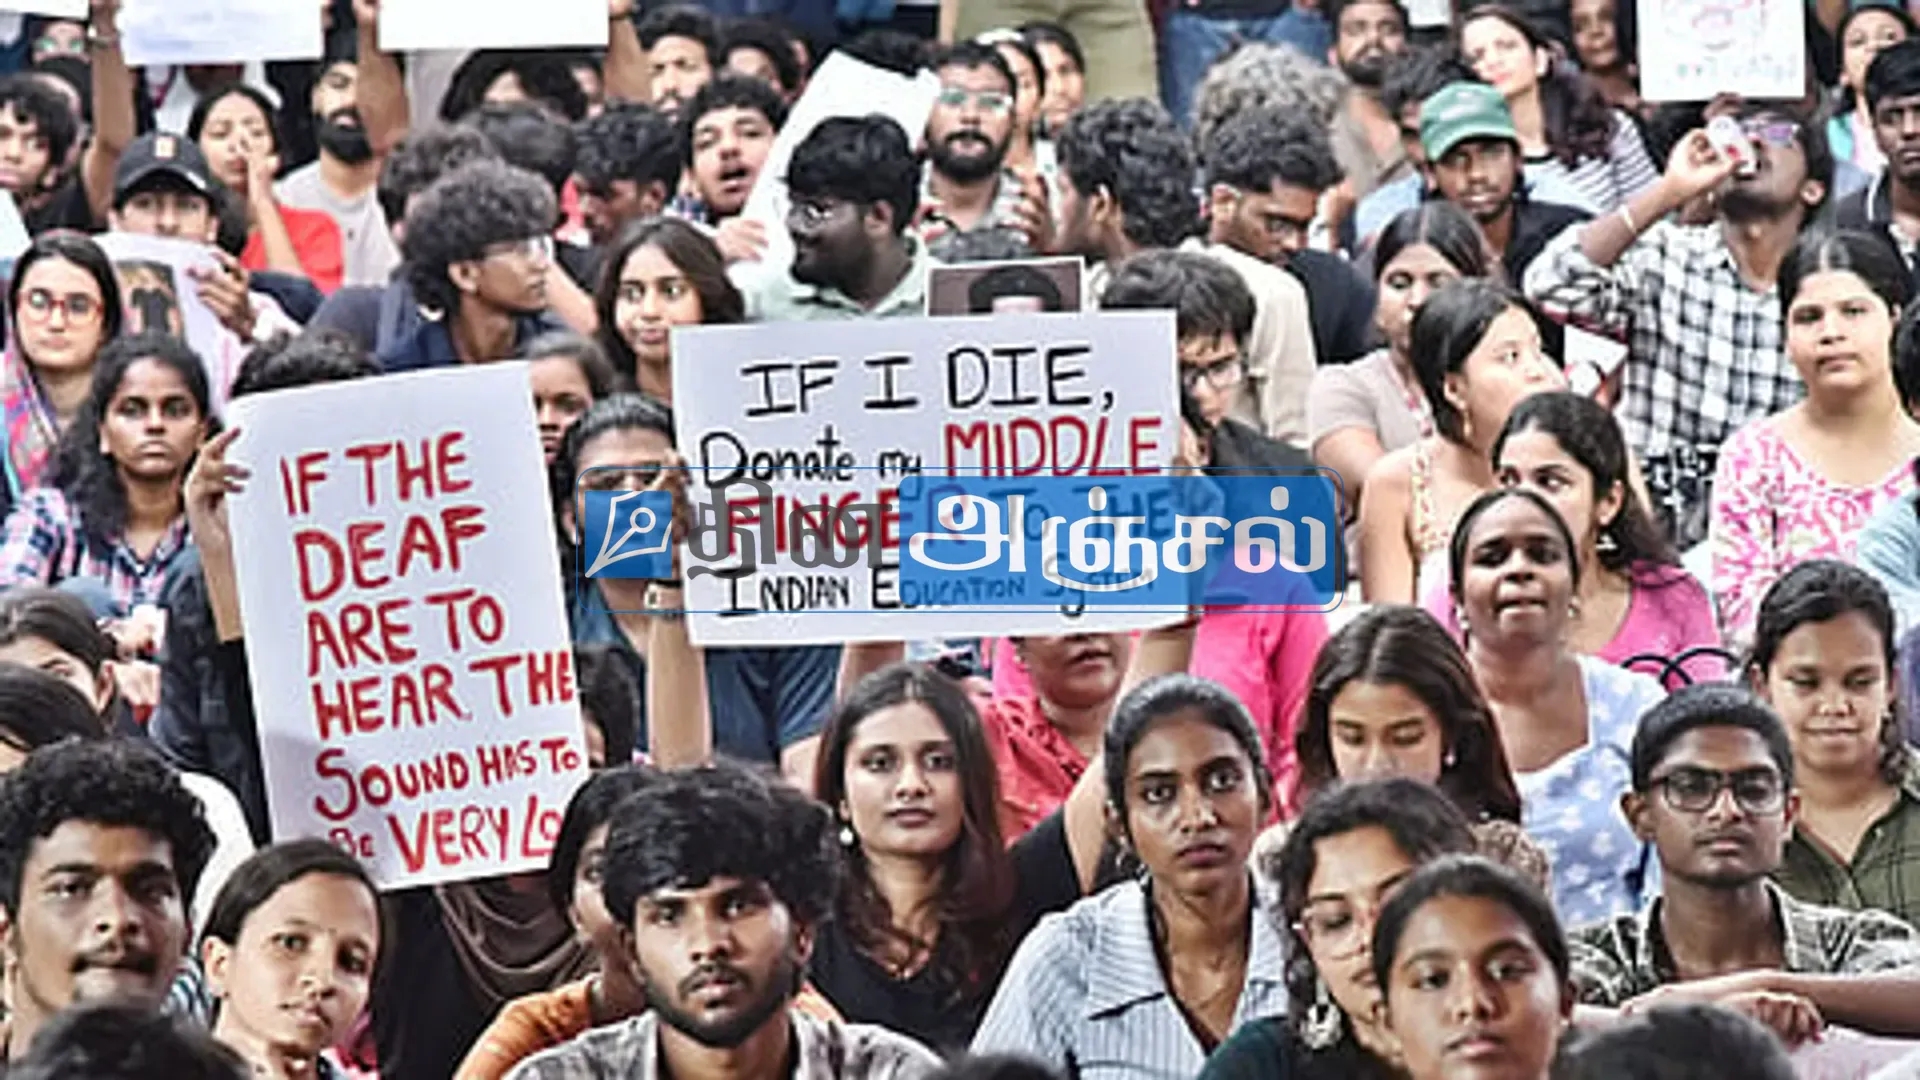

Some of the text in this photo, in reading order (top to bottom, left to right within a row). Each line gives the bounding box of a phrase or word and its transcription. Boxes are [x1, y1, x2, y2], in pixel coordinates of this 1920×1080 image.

[741, 346, 1114, 416] IF I DIE,
[280, 432, 473, 515] IF THE
[700, 425, 855, 488] Donate
[944, 416, 1161, 478] MIDDLE
[294, 507, 485, 601] DEAF
[714, 568, 849, 616] INDIAN
[307, 588, 504, 677] ARE TO
[311, 651, 573, 740] HEAR THE
[314, 748, 470, 821] SOUND
[476, 740, 538, 786] HAS
[387, 805, 509, 873] VERY
[520, 795, 562, 858] LO
